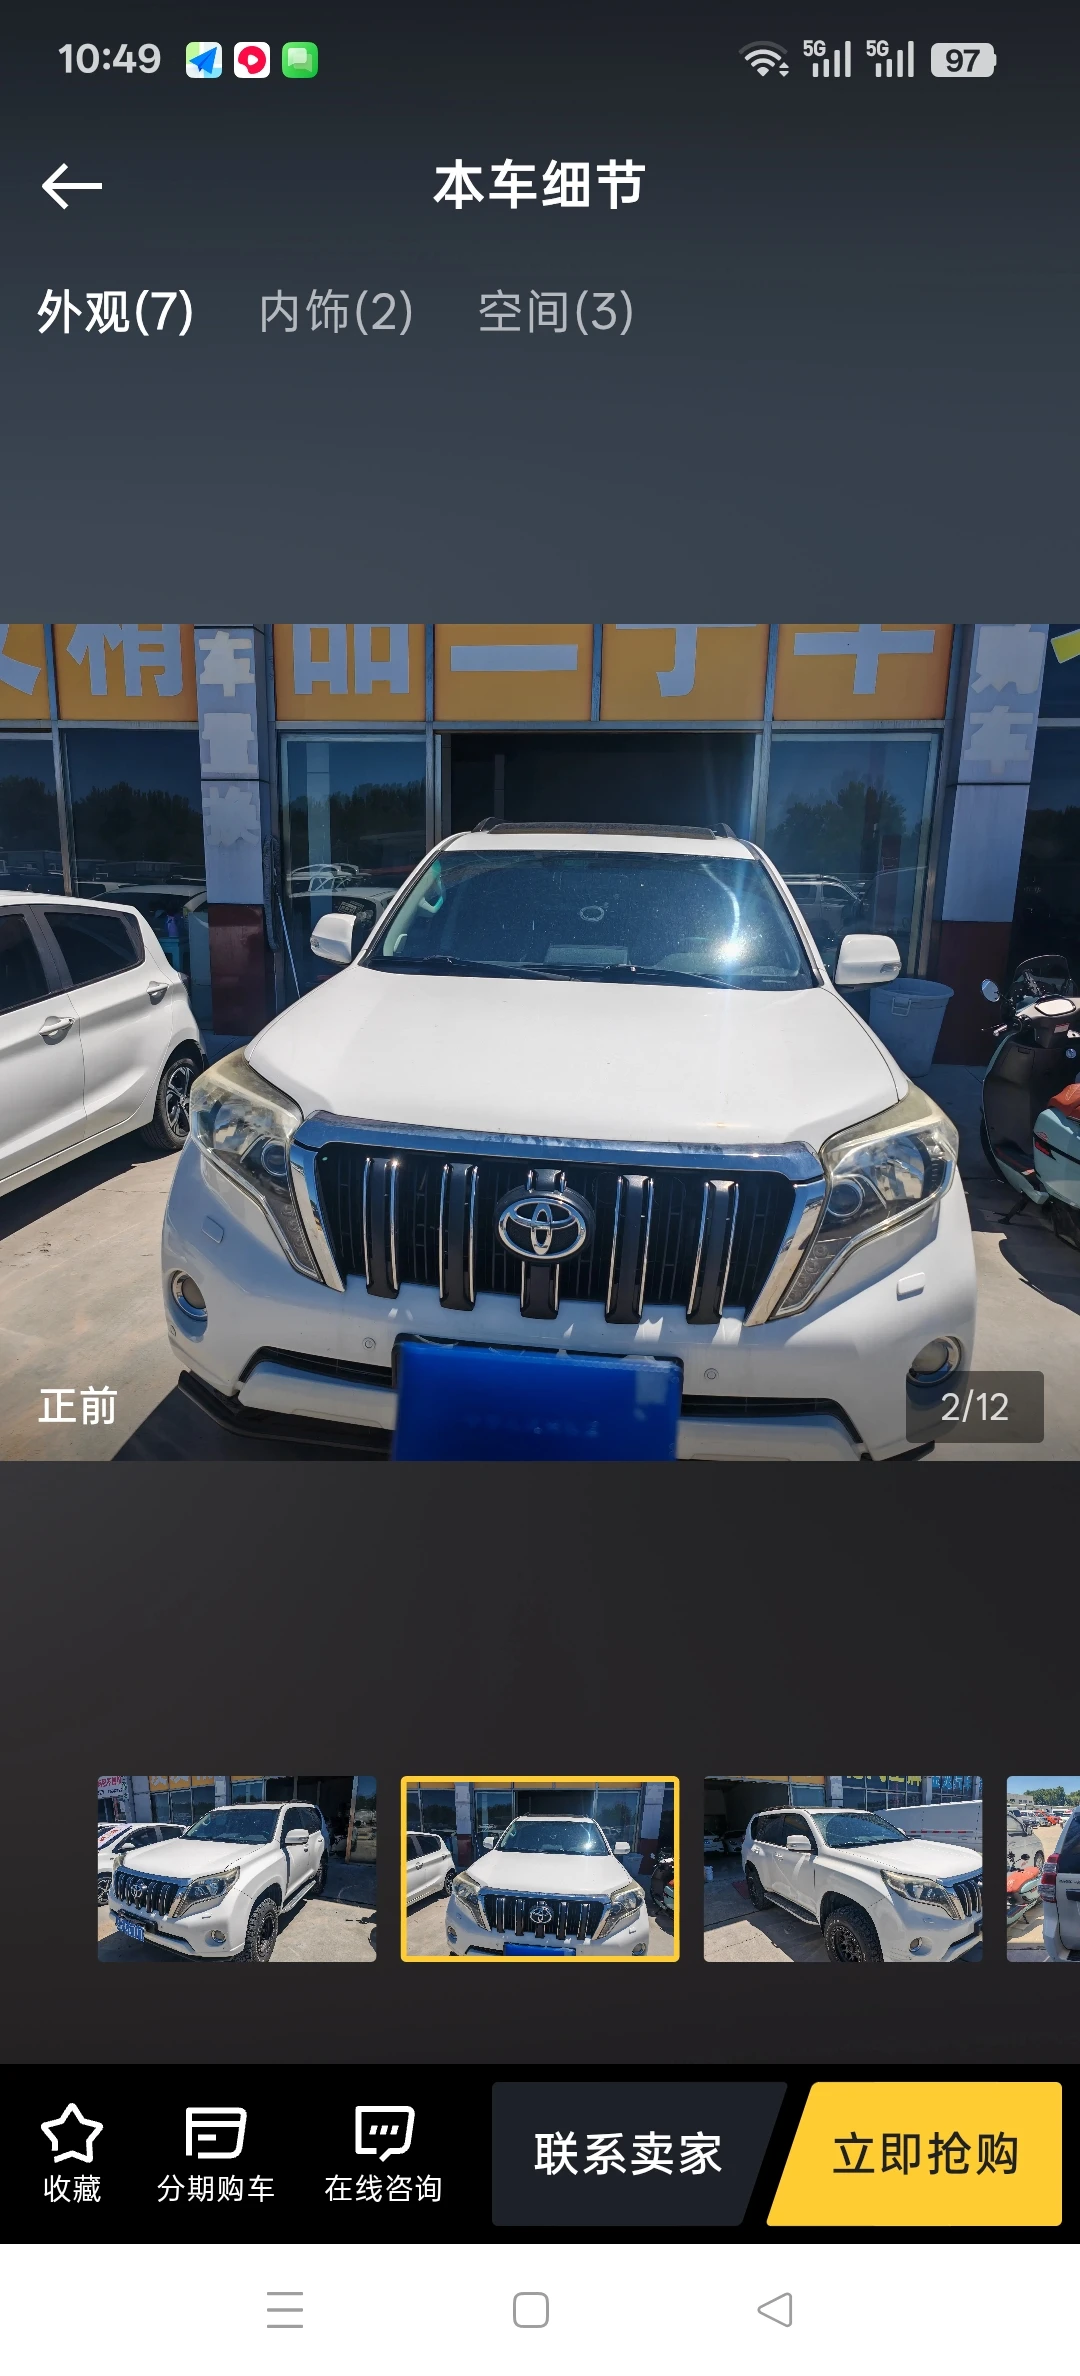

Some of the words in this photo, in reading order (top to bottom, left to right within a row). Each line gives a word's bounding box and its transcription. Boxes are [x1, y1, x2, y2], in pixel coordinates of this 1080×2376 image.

[58, 43, 161, 74] 10:49
[803, 39, 826, 57] 5G
[866, 39, 889, 57] 5G
[945, 48, 981, 73] 97
[432, 158, 646, 210] 本车细节
[37, 288, 193, 337] 外观(7)
[260, 288, 413, 337] 内饰(2)
[478, 288, 634, 337] 空间(3)
[534, 2130, 722, 2176] 联系卖家
[832, 2131, 1018, 2176] 立即抢购
[43, 2174, 102, 2204] 收藏
[157, 2174, 275, 2204] 分期购车
[324, 2174, 442, 2204] 在线咨询
